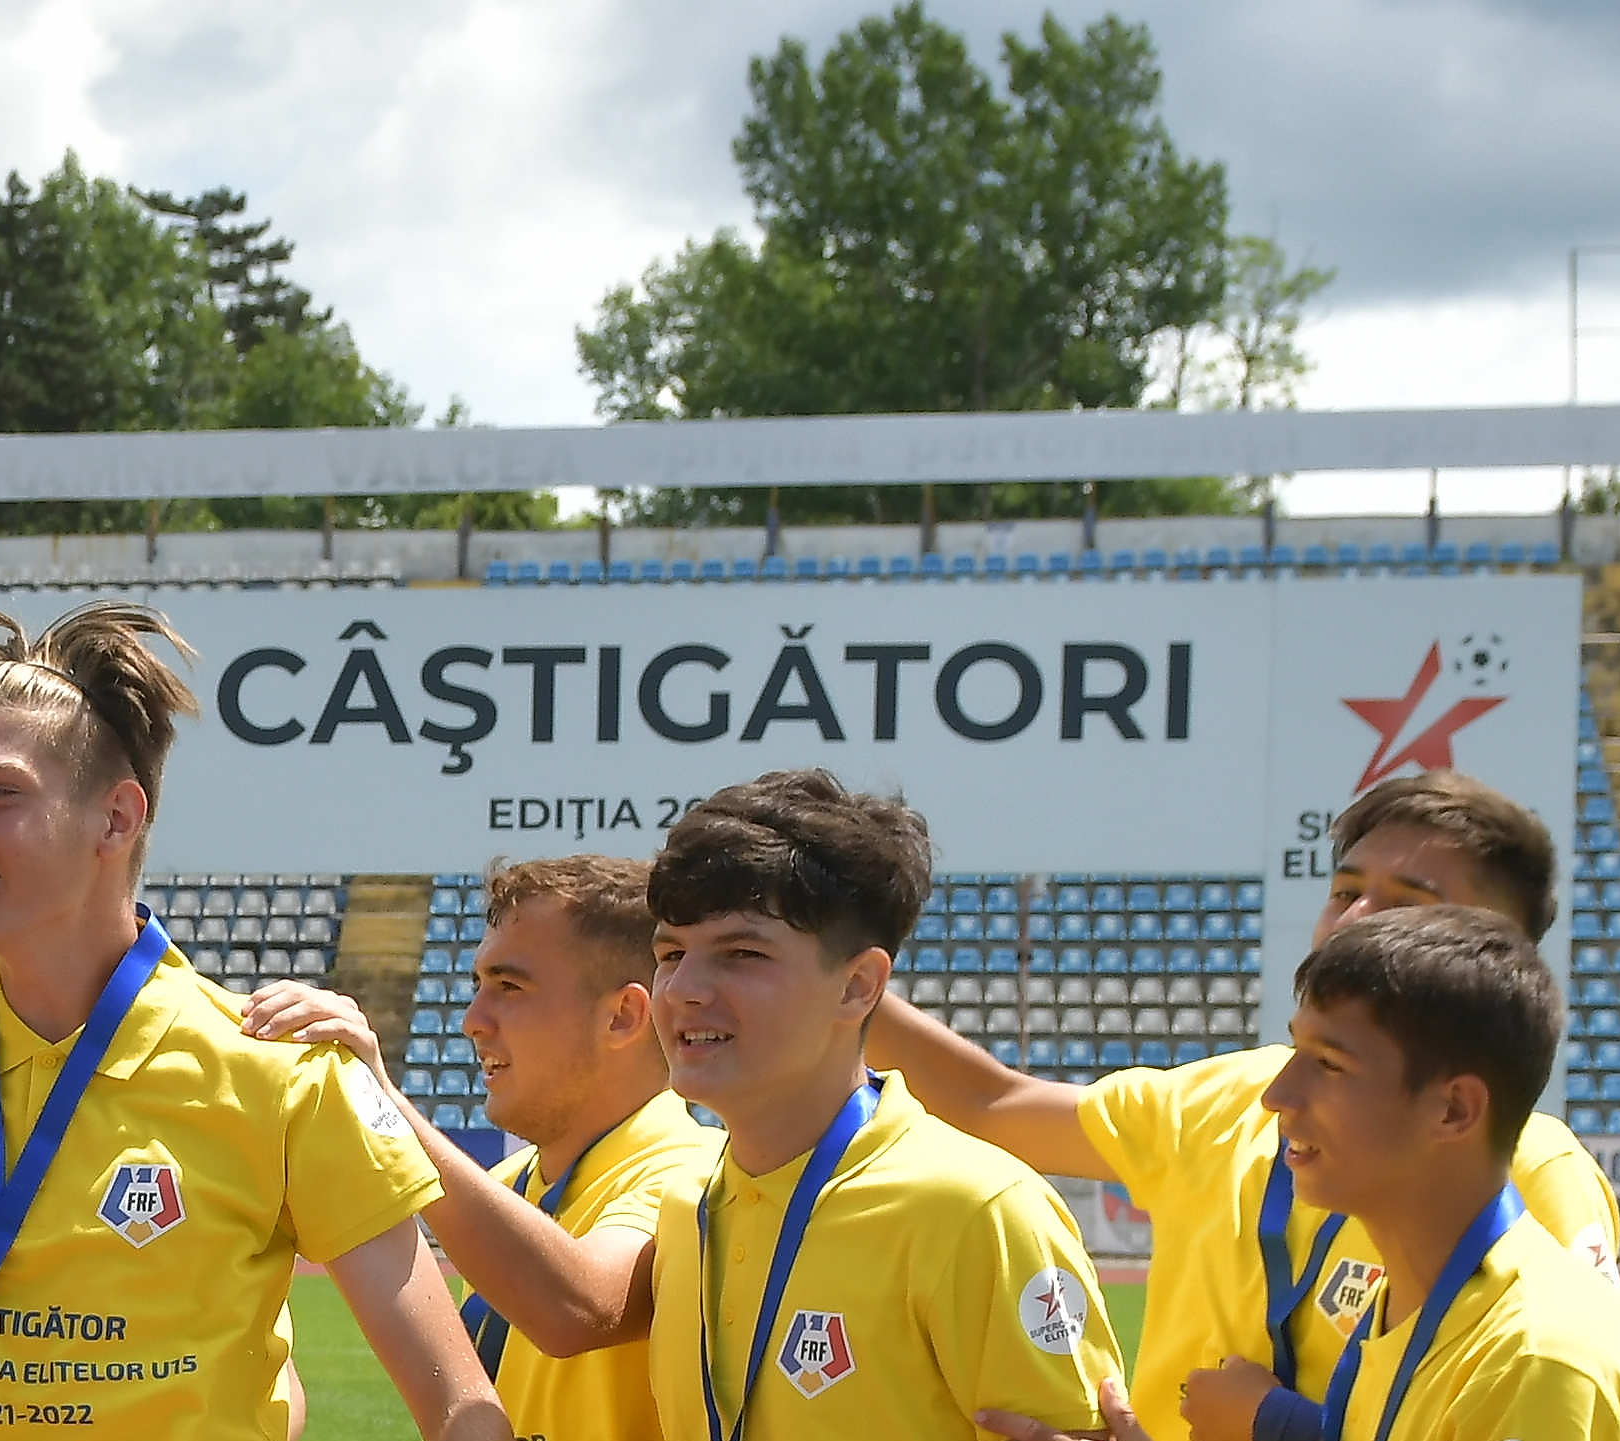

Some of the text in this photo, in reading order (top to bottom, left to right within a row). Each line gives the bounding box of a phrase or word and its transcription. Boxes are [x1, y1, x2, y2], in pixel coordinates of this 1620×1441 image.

[126, 1190, 158, 1215] FRF
[799, 1340, 828, 1364] FRF
[23, 1361, 145, 1384] ELITELOR
[151, 1355, 198, 1379] U15
